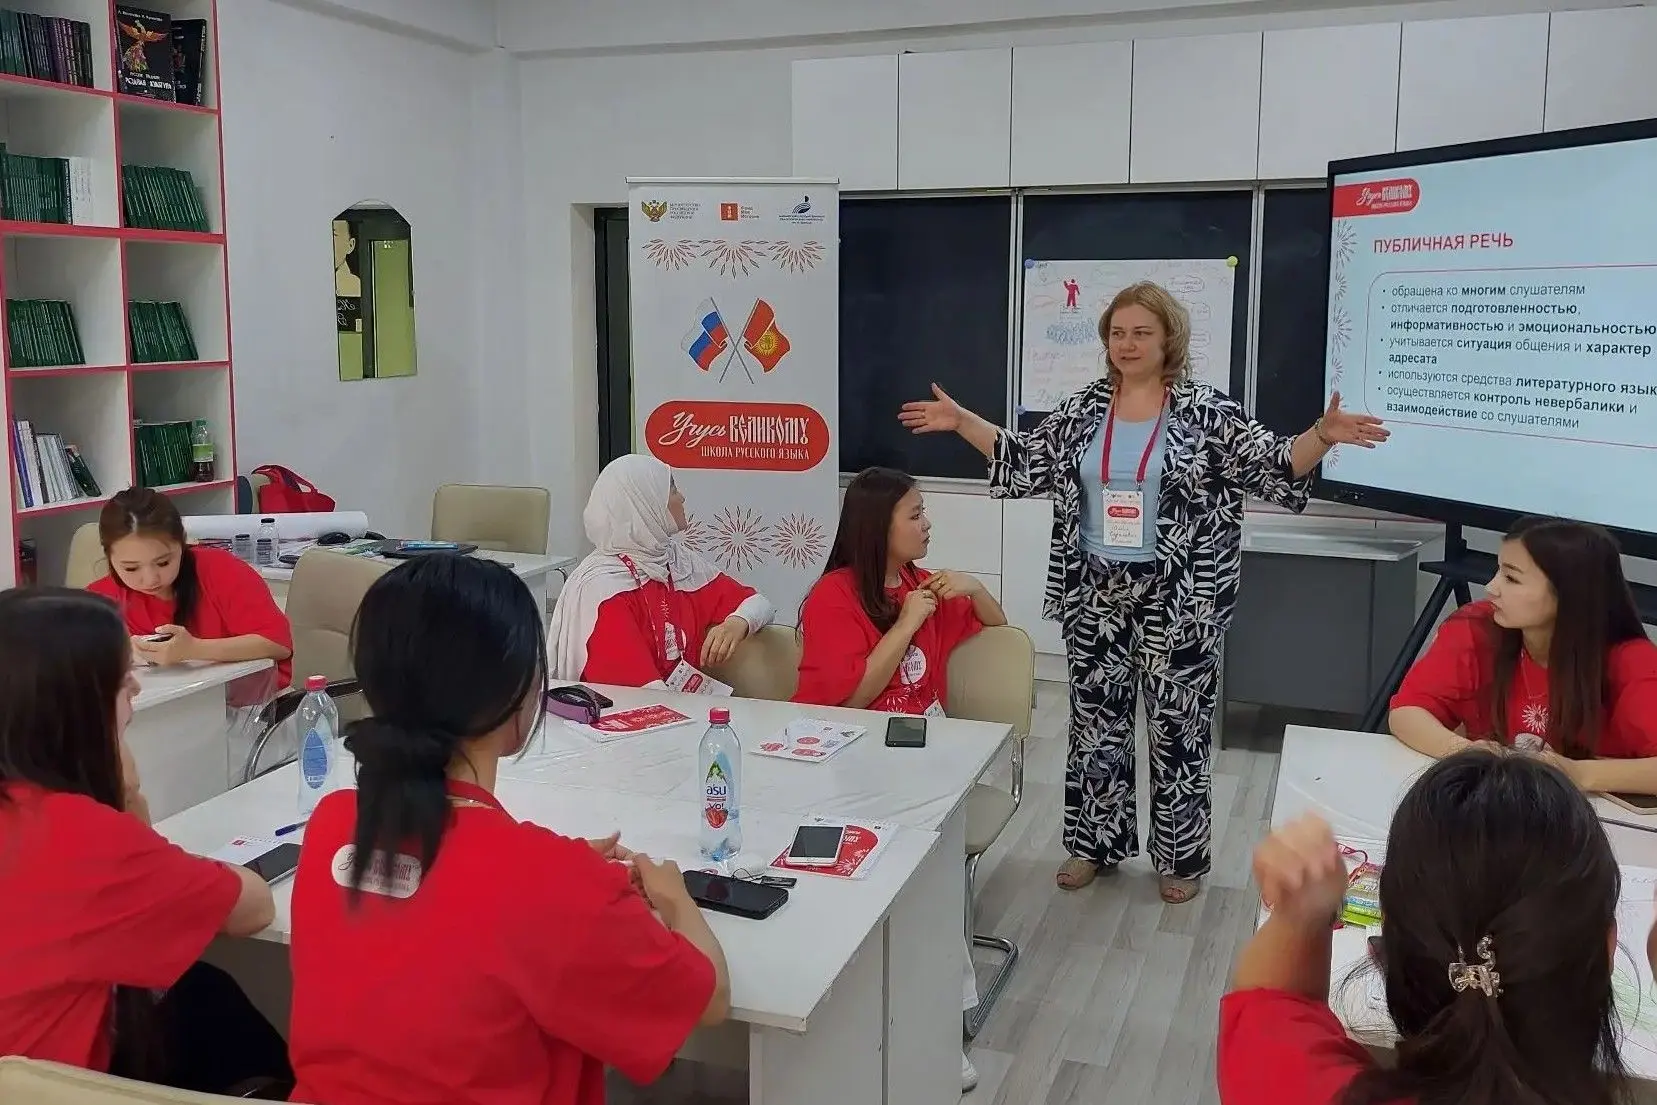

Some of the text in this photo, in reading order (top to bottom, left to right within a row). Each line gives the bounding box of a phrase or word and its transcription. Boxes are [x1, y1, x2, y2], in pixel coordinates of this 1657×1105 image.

[1373, 232, 1514, 254] ПУБЛИЧНАЯ РЕЧЬ
[1391, 285, 1585, 299] обращена ко многим слушателям
[1391, 303, 1581, 316] отличается подготовленностью,
[1390, 319, 1657, 335] информативностью и эмоциональностью
[1389, 337, 1652, 358] учитывается ситуация общения и характер
[1388, 353, 1438, 365] адресата
[1388, 369, 1458, 383] используются
[1460, 374, 1512, 386] средства
[1515, 377, 1616, 393] литературного
[1387, 386, 1638, 414] осуществляется контроль невербалики и
[1386, 402, 1579, 429] взаимодействие со слушателями
[658, 411, 810, 448] Учусь ВЕЛИКОМУ
[701, 446, 810, 460] ШКОЛА РУССКОГО ЯЗЫКА
